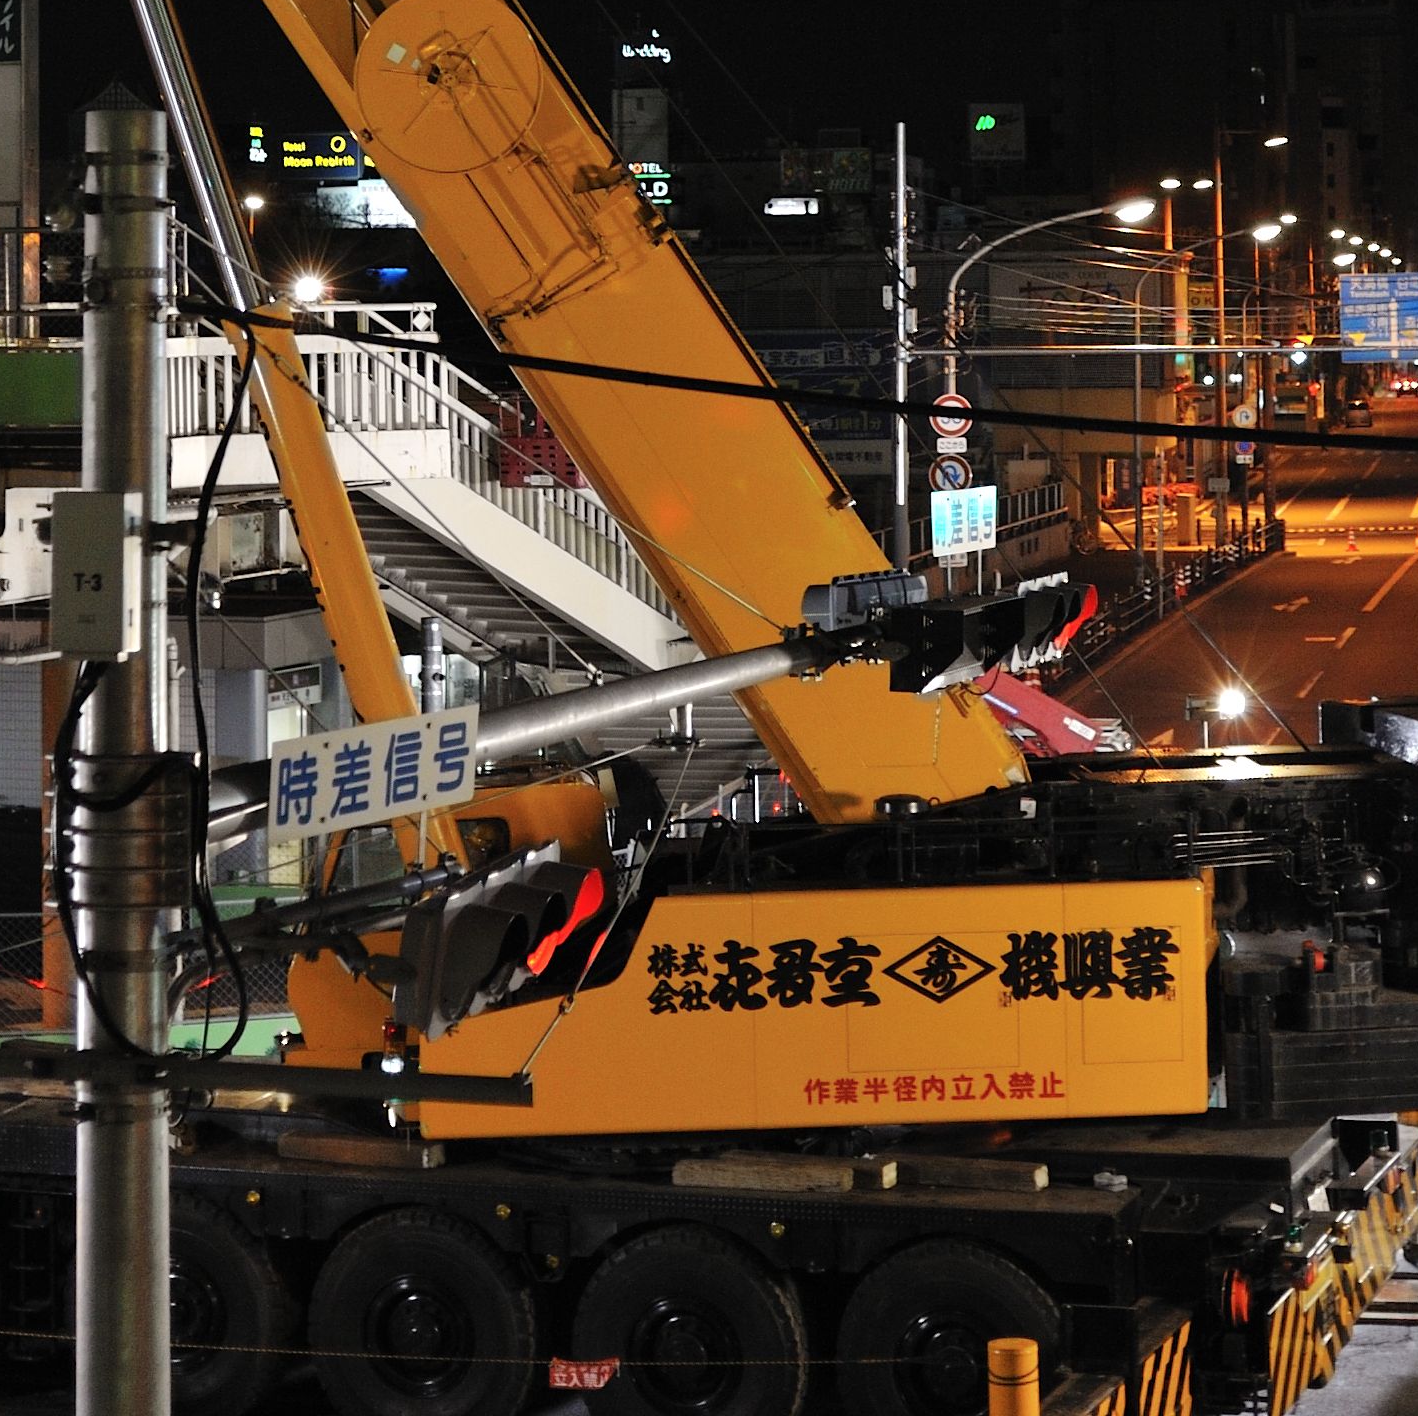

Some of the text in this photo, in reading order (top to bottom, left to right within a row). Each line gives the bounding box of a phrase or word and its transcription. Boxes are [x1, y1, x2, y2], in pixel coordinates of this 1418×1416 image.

[72, 573, 103, 593] T-3
[275, 721, 471, 826] 時差信号
[647, 942, 709, 978] 株式
[646, 979, 712, 1016] 会社
[803, 1071, 1066, 1106] 作業半径内立入禁止
